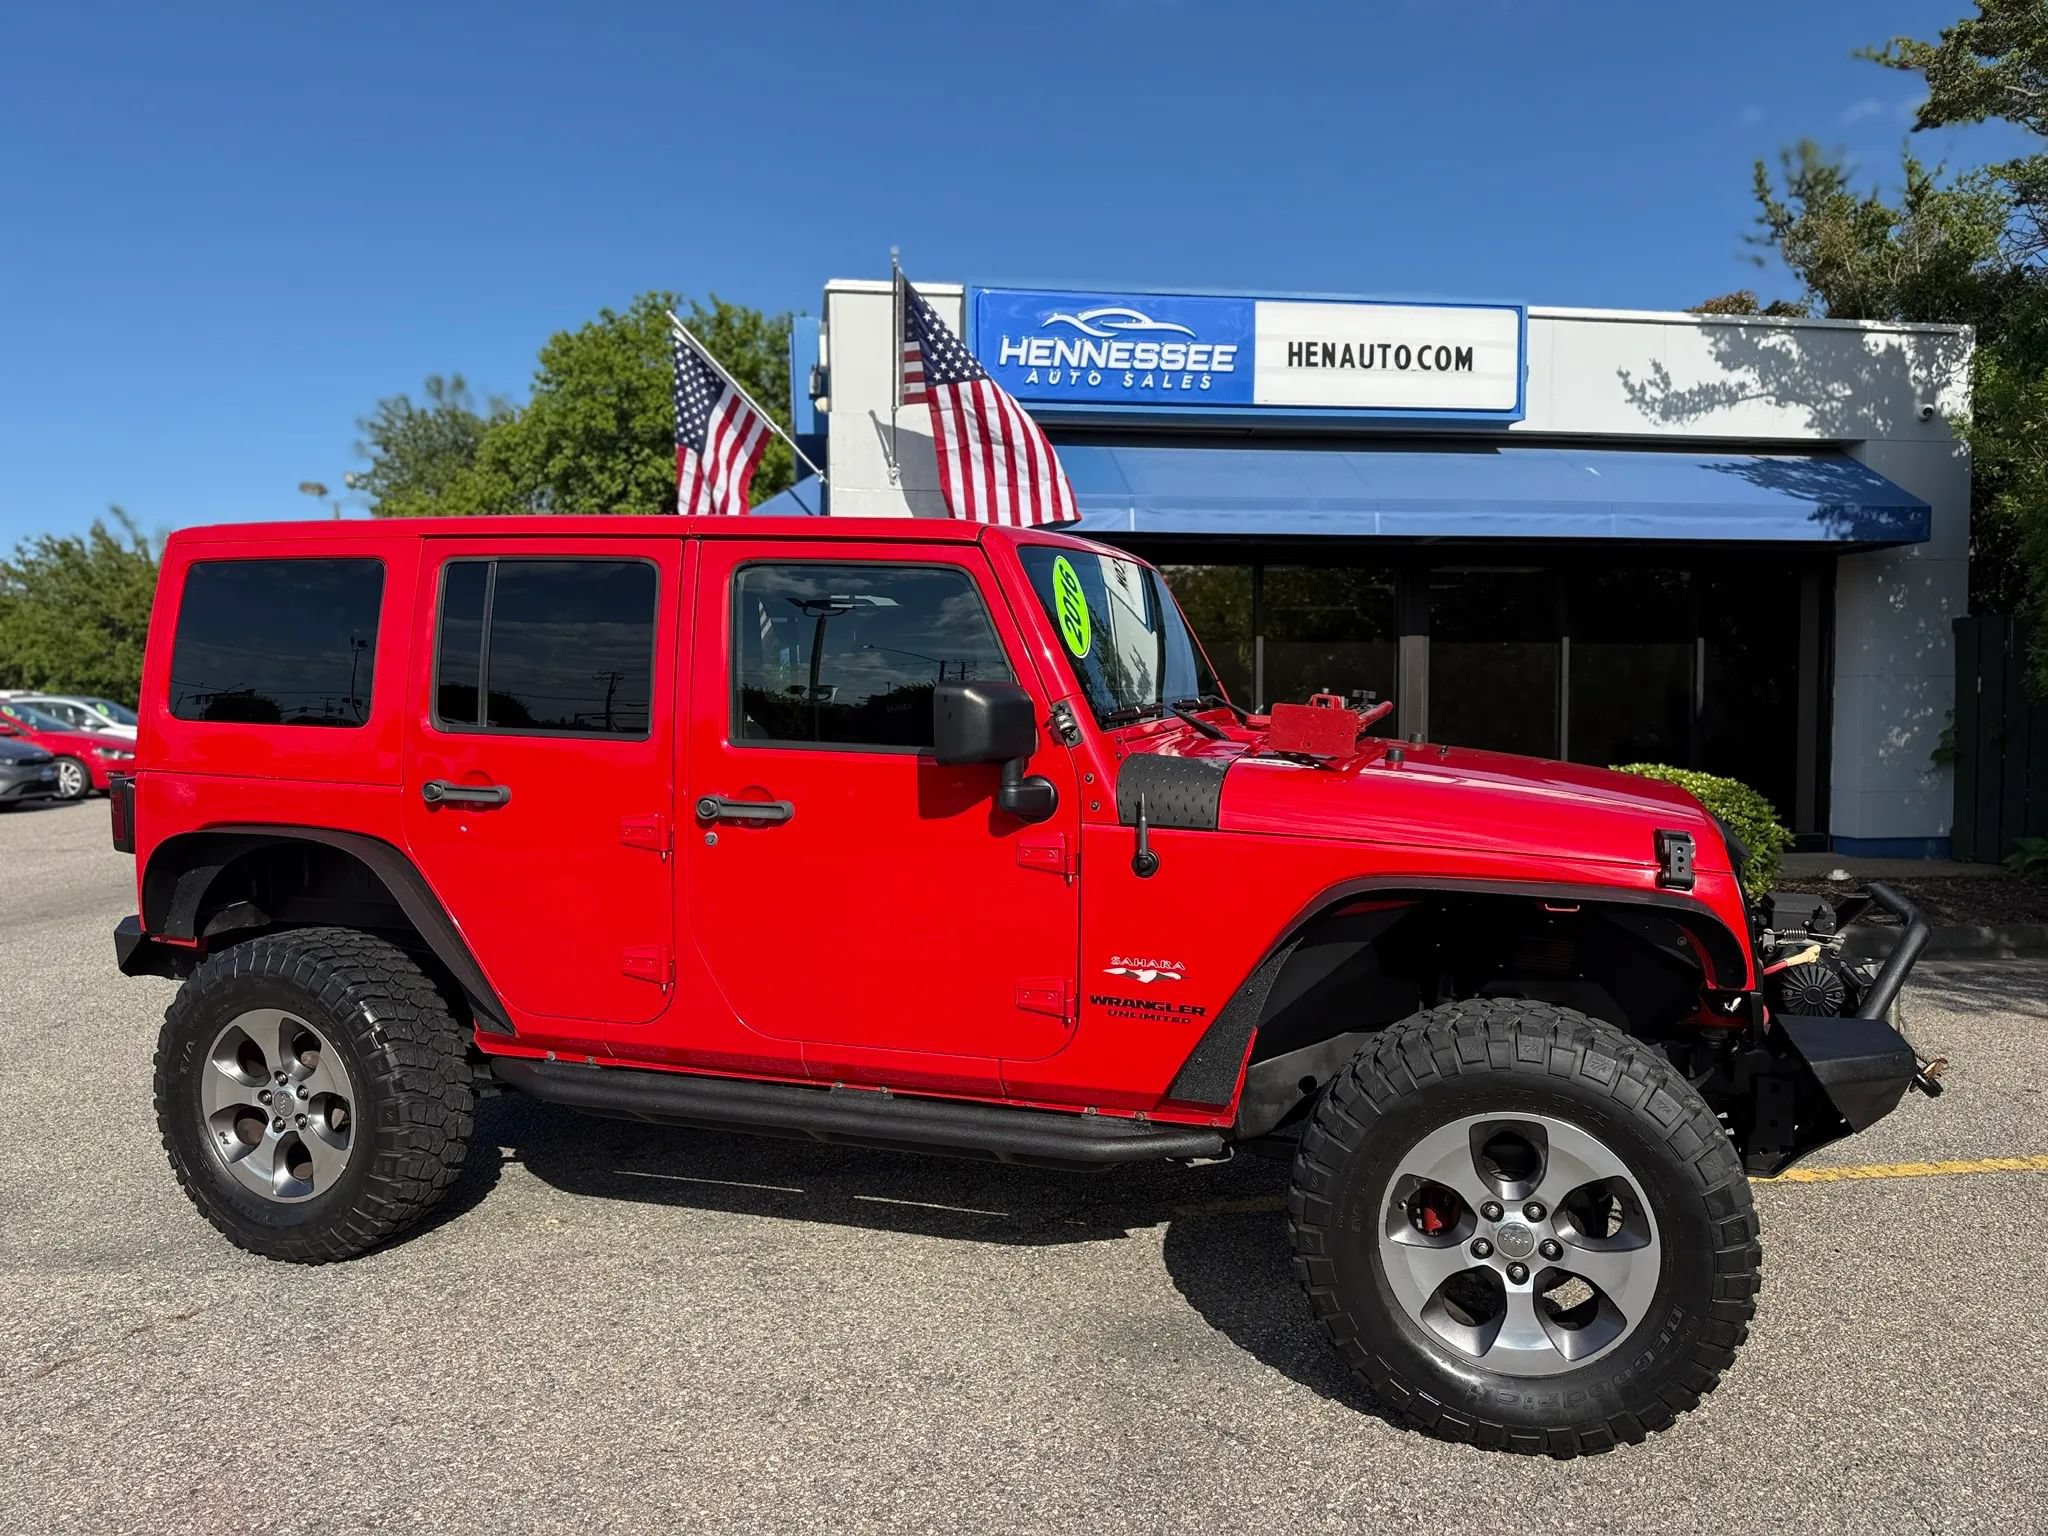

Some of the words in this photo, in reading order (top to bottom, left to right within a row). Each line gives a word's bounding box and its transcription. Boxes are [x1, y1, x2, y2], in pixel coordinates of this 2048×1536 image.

[999, 335, 1238, 374] HENNESSEE
[1025, 368, 1102, 388] AUTO
[1122, 372, 1213, 392] SALES
[1059, 563, 1083, 648] 2016
[1110, 956, 1186, 970] SAHARA
[1090, 995, 1206, 1016] WRANGLER
[1108, 1010, 1191, 1024] UNLIMITED
